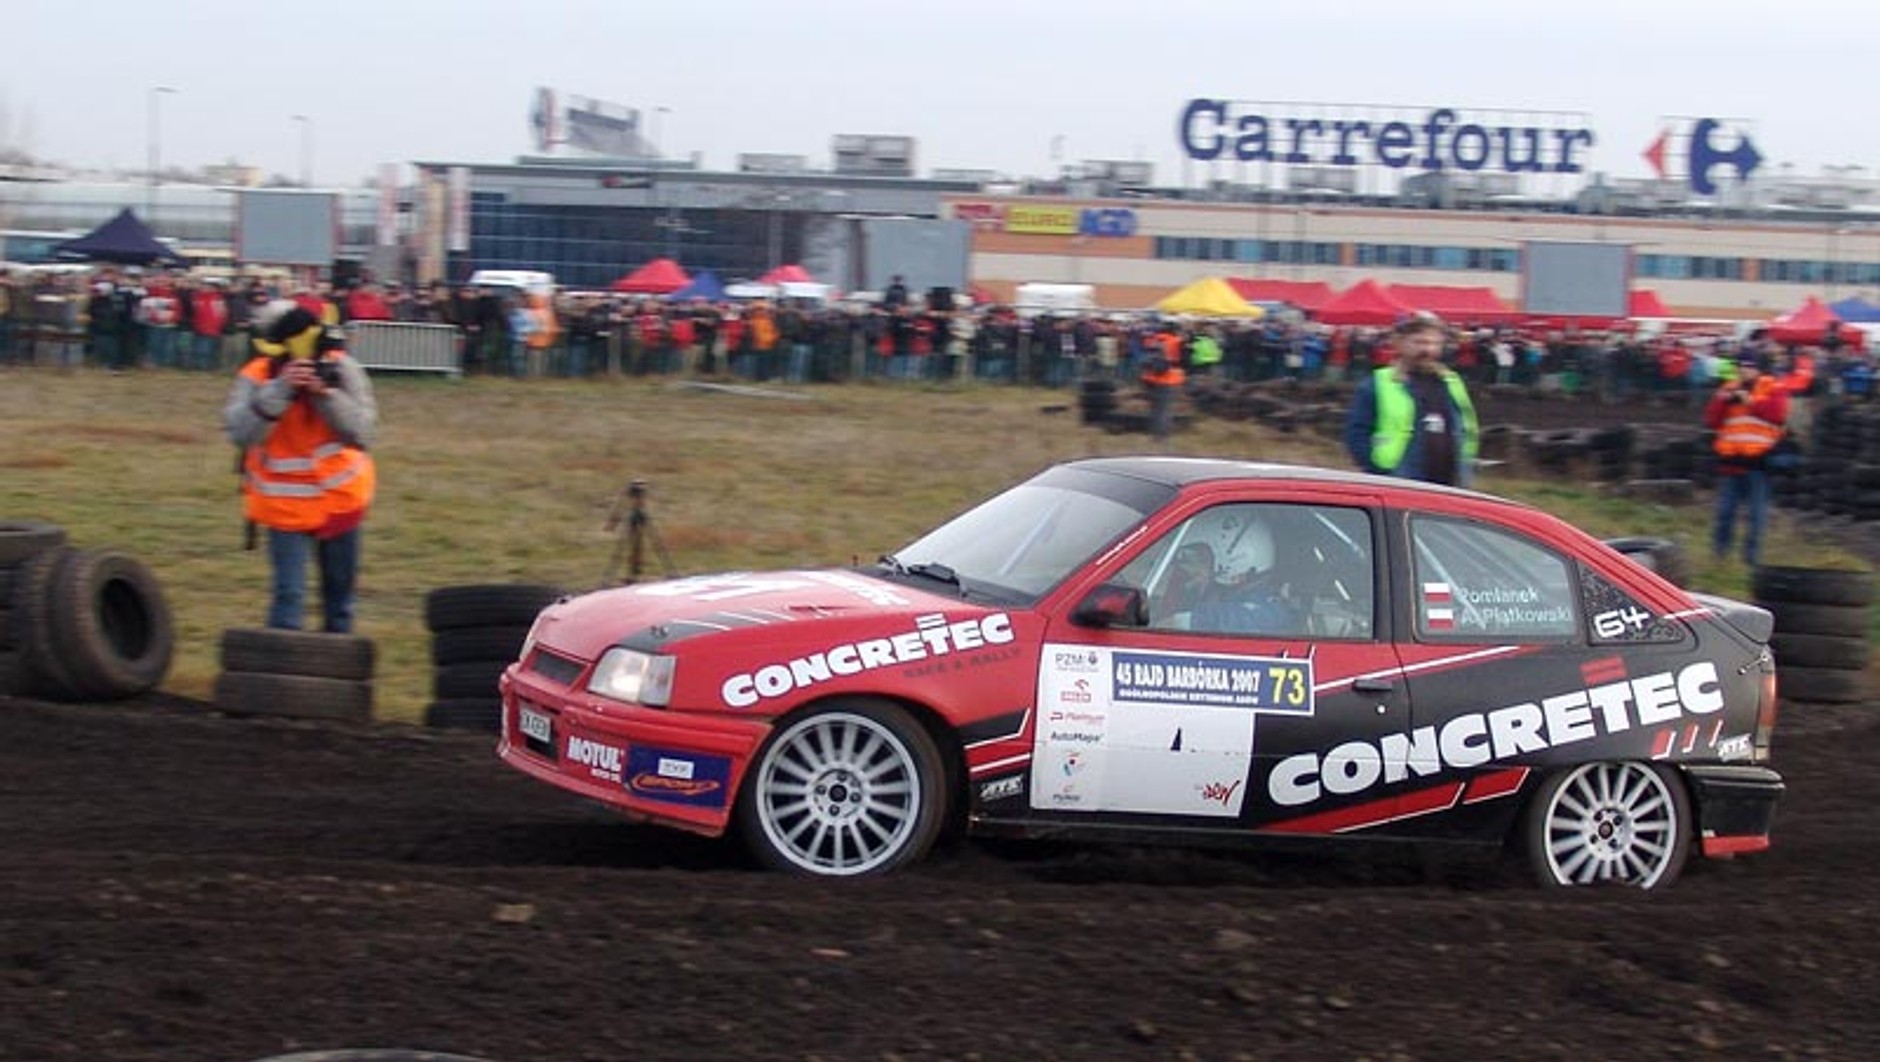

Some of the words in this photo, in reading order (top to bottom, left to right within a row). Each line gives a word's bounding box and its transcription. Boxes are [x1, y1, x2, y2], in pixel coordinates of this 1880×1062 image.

[1181, 98, 1592, 173] Carrefour
[1594, 606, 1650, 638] 64
[721, 612, 1015, 708] CONCRETEC
[1116, 661, 1132, 686] 45
[1133, 663, 1165, 688] RAJD
[1165, 660, 1230, 691] BARBÓRKA
[1231, 669, 1261, 693] 2007
[1269, 667, 1306, 705] 73
[567, 735, 622, 772] MOTUL
[1268, 662, 1725, 807] CONCRETEC
